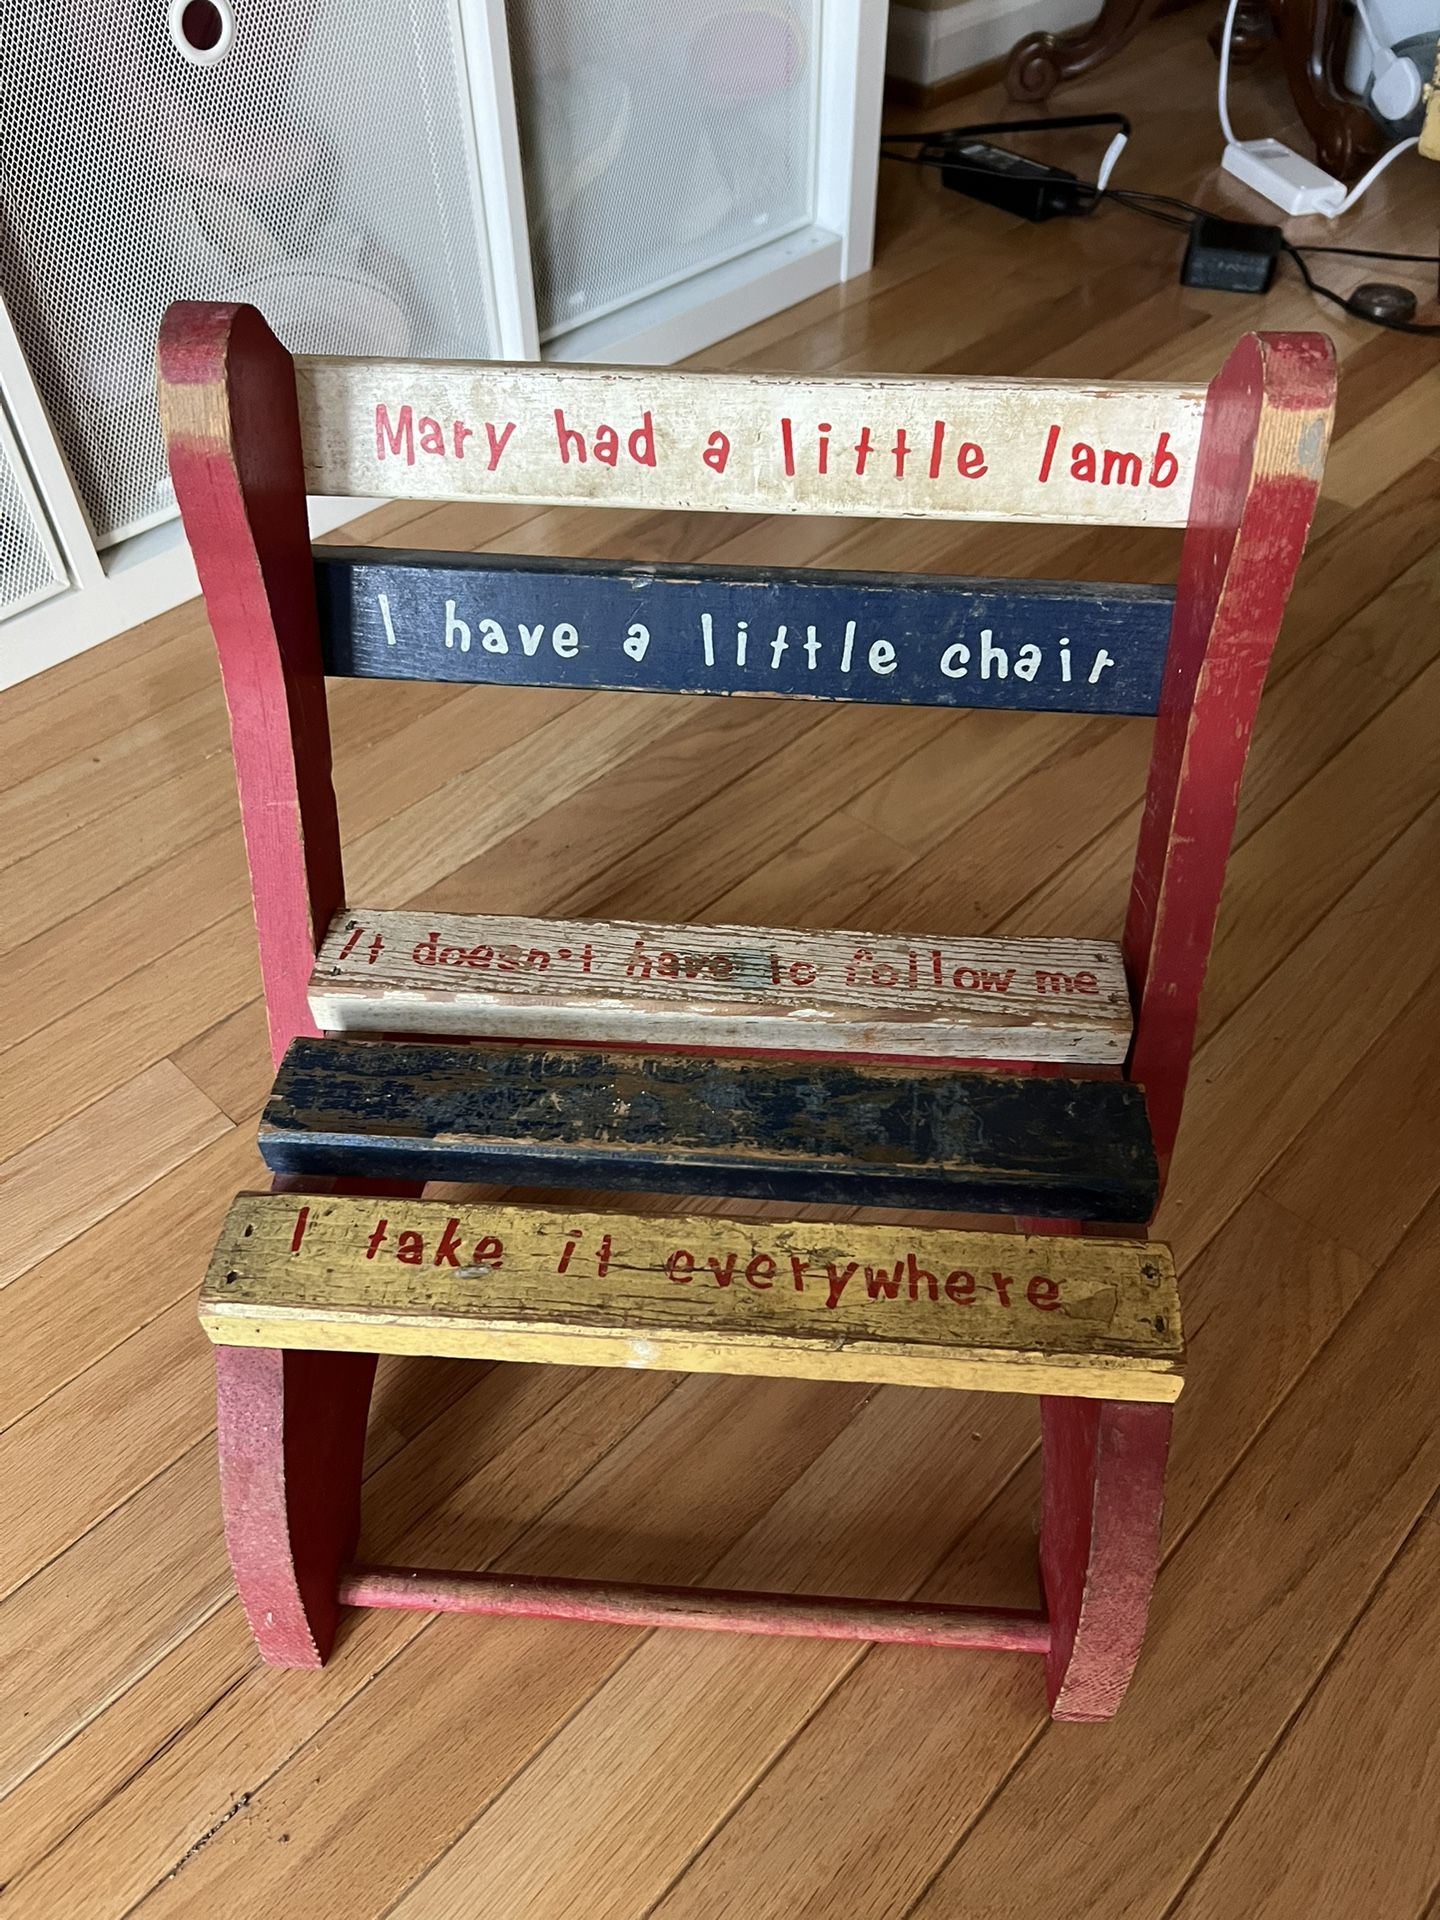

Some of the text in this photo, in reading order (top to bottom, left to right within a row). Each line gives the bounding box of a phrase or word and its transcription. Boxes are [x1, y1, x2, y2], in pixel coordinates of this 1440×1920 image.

[377, 406, 1178, 488] Mary had a little lamb
[378, 591, 1114, 683] I have a little chair
[339, 927, 385, 965] It
[845, 949, 1016, 992] follow
[1035, 970, 1100, 994] me
[292, 1208, 1057, 1310] I take it everywhere
